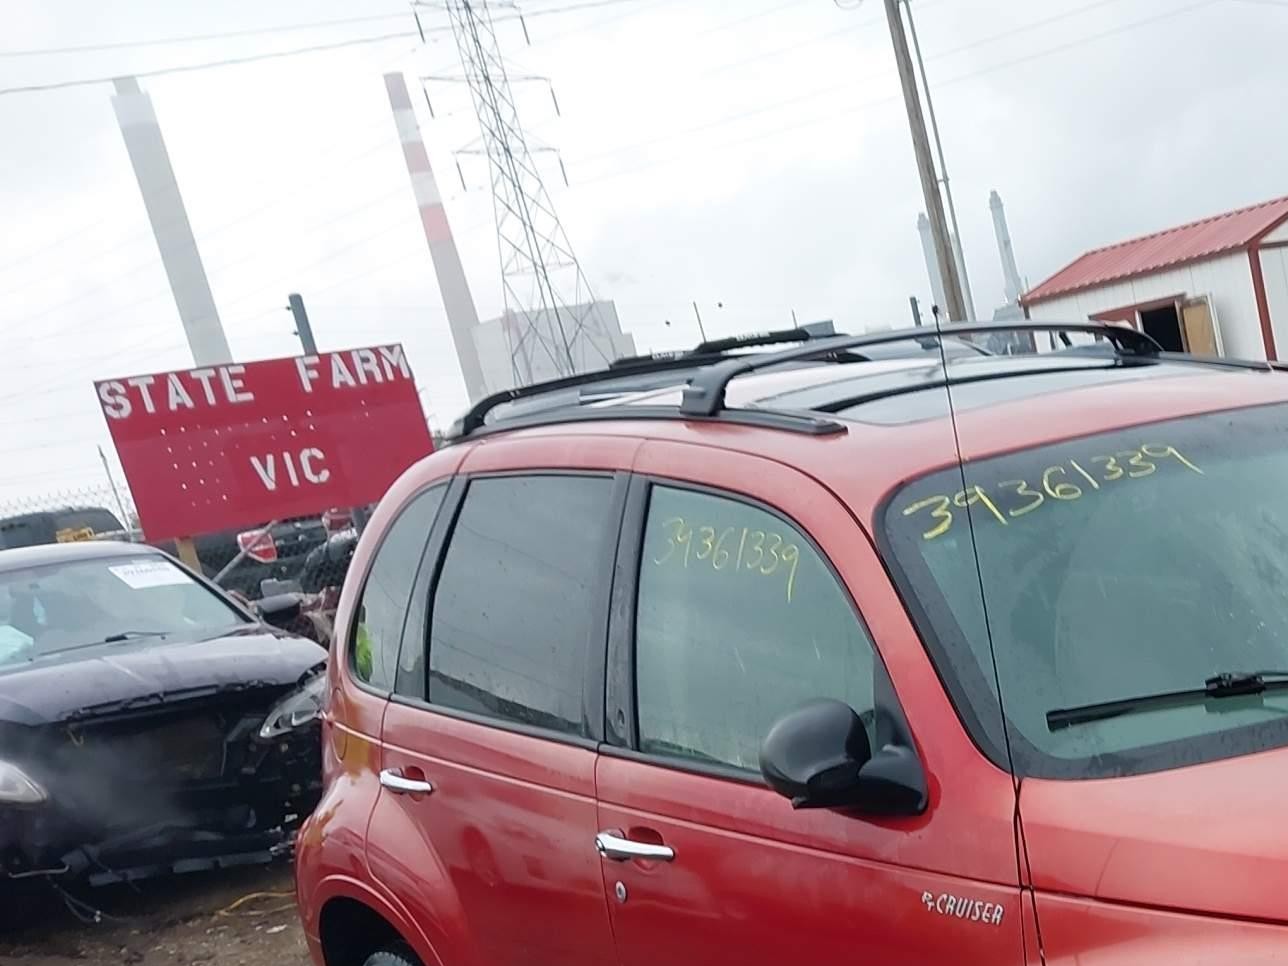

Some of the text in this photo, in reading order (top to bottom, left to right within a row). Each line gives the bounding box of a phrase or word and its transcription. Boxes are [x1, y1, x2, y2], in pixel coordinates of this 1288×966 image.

[98, 344, 411, 419] STATE FARM
[251, 448, 330, 491] VIC
[903, 444, 1204, 539] 39361339
[654, 517, 799, 603] 39361339
[936, 893, 1004, 925] CRUISER
